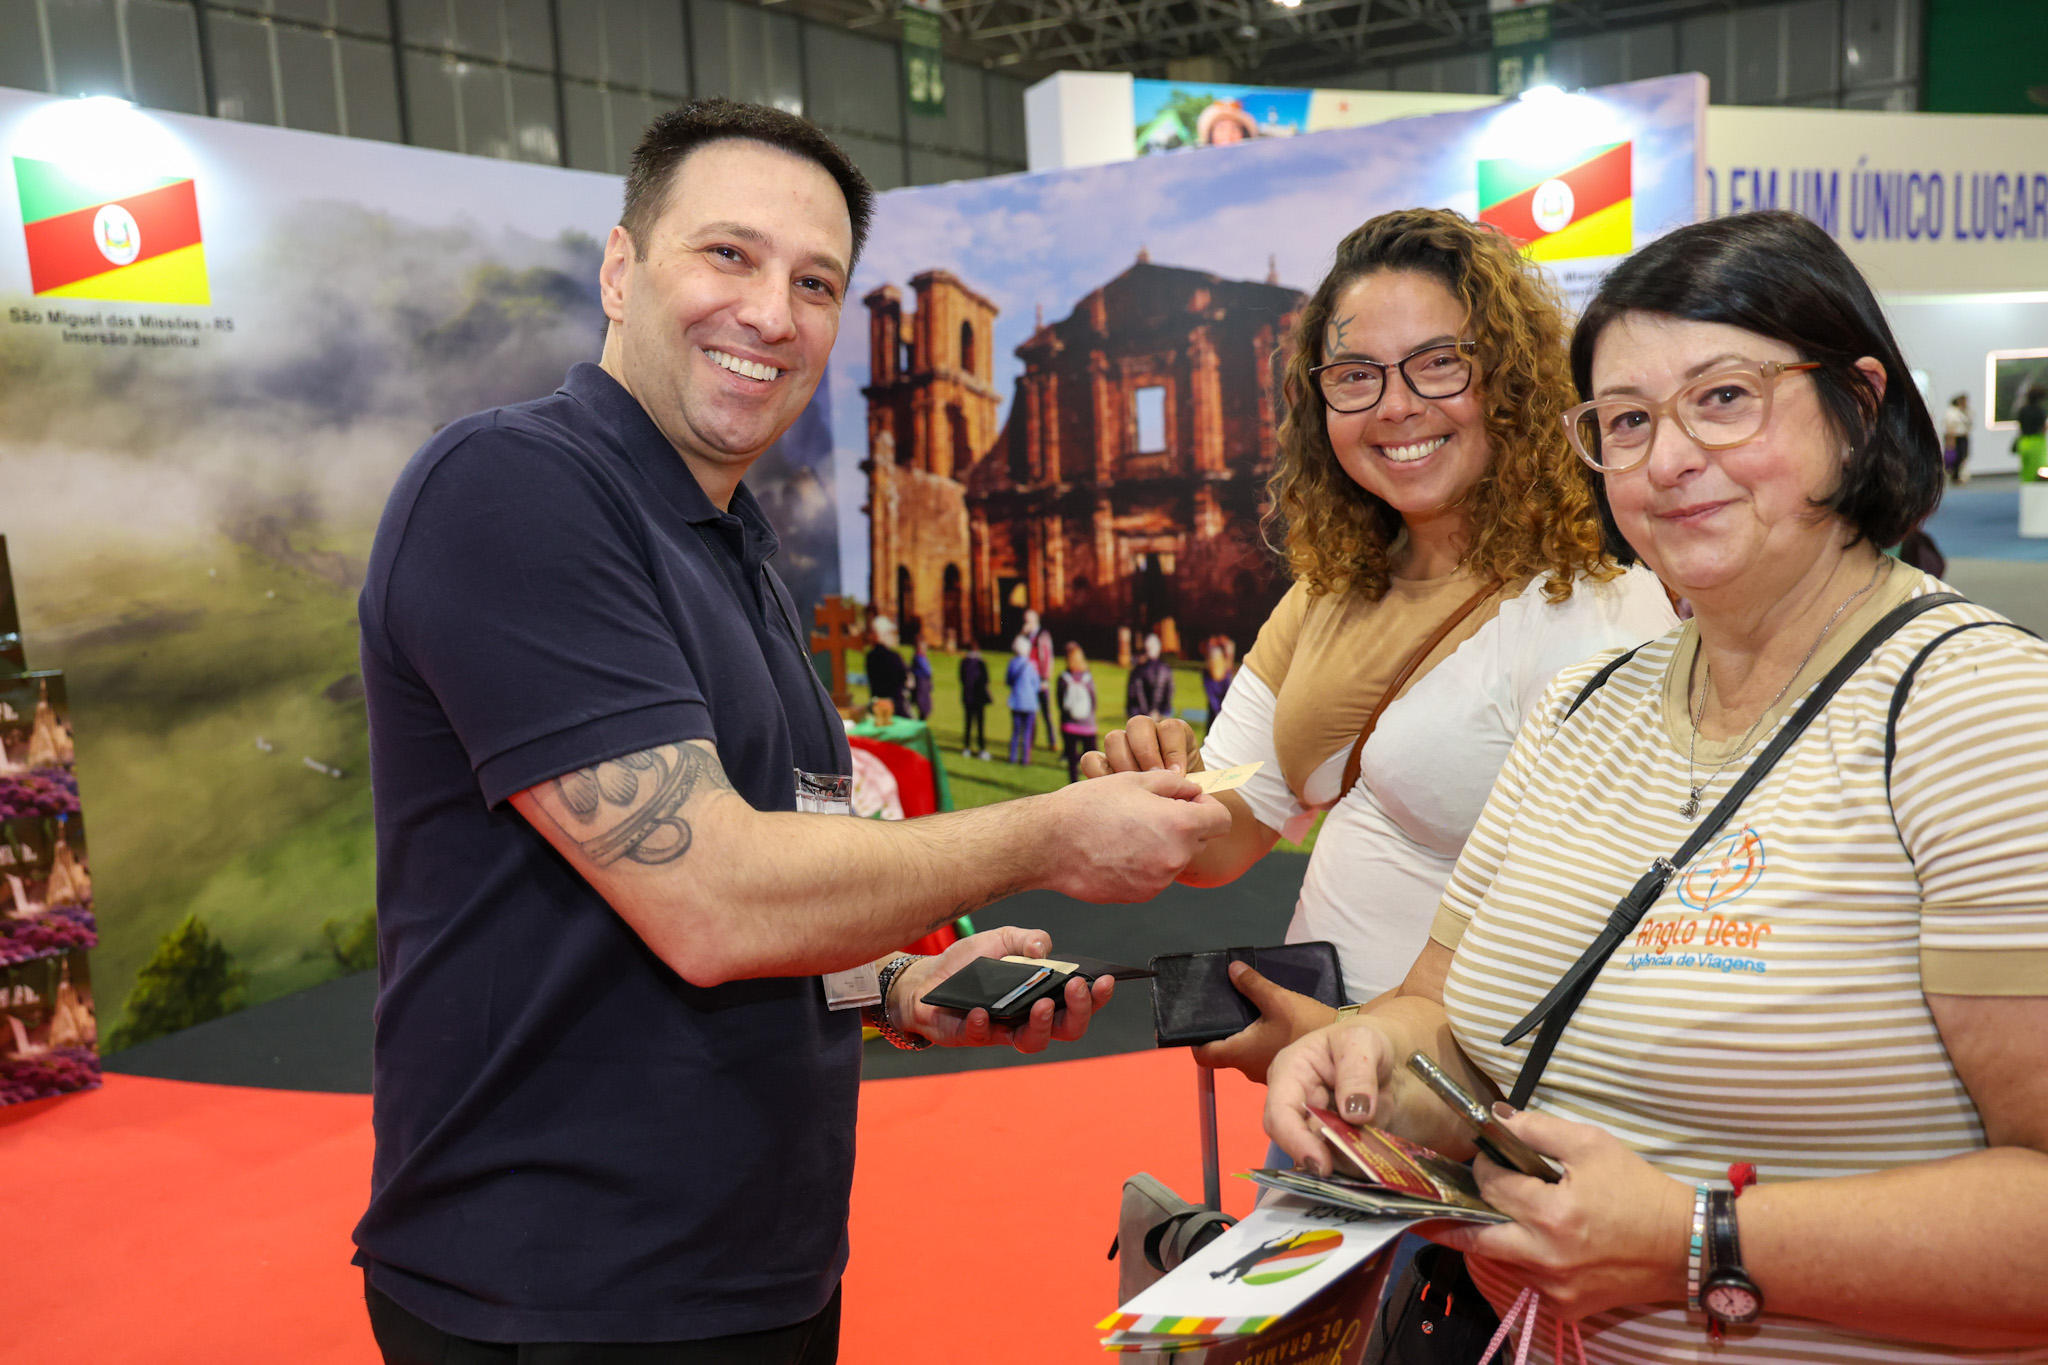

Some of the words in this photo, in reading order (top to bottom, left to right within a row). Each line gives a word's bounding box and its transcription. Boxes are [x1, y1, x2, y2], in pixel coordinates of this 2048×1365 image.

[1850, 153, 1943, 240] ÚNICO
[1953, 170, 2048, 239] LUGAR
[9, 307, 42, 324] São
[47, 309, 103, 329] Miguel
[106, 311, 135, 329] das
[213, 316, 235, 332] RS
[1635, 915, 1698, 955] Anglo
[1704, 914, 1772, 949] Dear
[1625, 952, 1673, 971] Agência
[1676, 953, 1696, 967] de
[1698, 952, 1766, 973] Viagens
